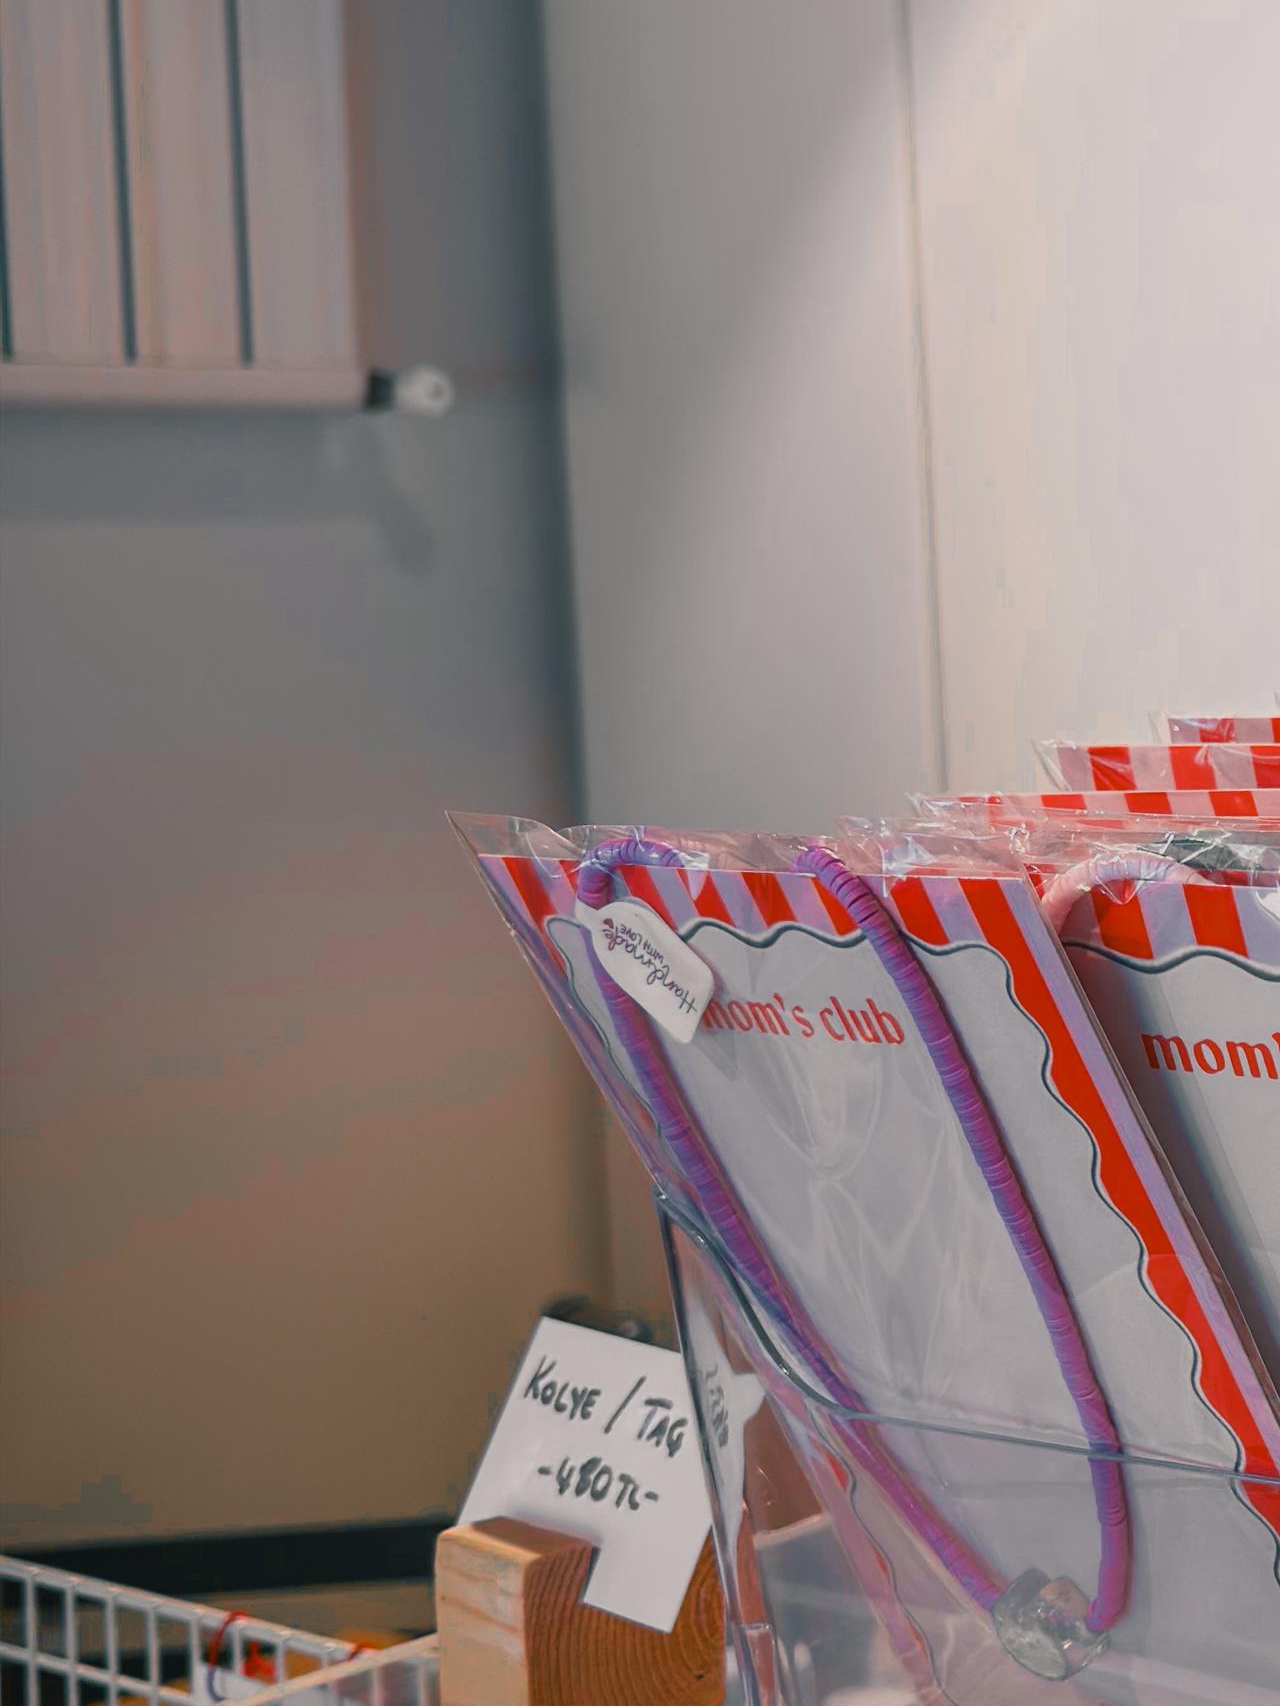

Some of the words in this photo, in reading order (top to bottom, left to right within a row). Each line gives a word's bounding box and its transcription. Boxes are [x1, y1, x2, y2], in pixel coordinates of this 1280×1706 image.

[619, 923, 642, 945] LOVE
[643, 939, 664, 965] WITH
[602, 927, 698, 1014] Handmade
[702, 993, 814, 1038] mom's
[819, 996, 905, 1045] club
[524, 1355, 602, 1422] KOLYE
